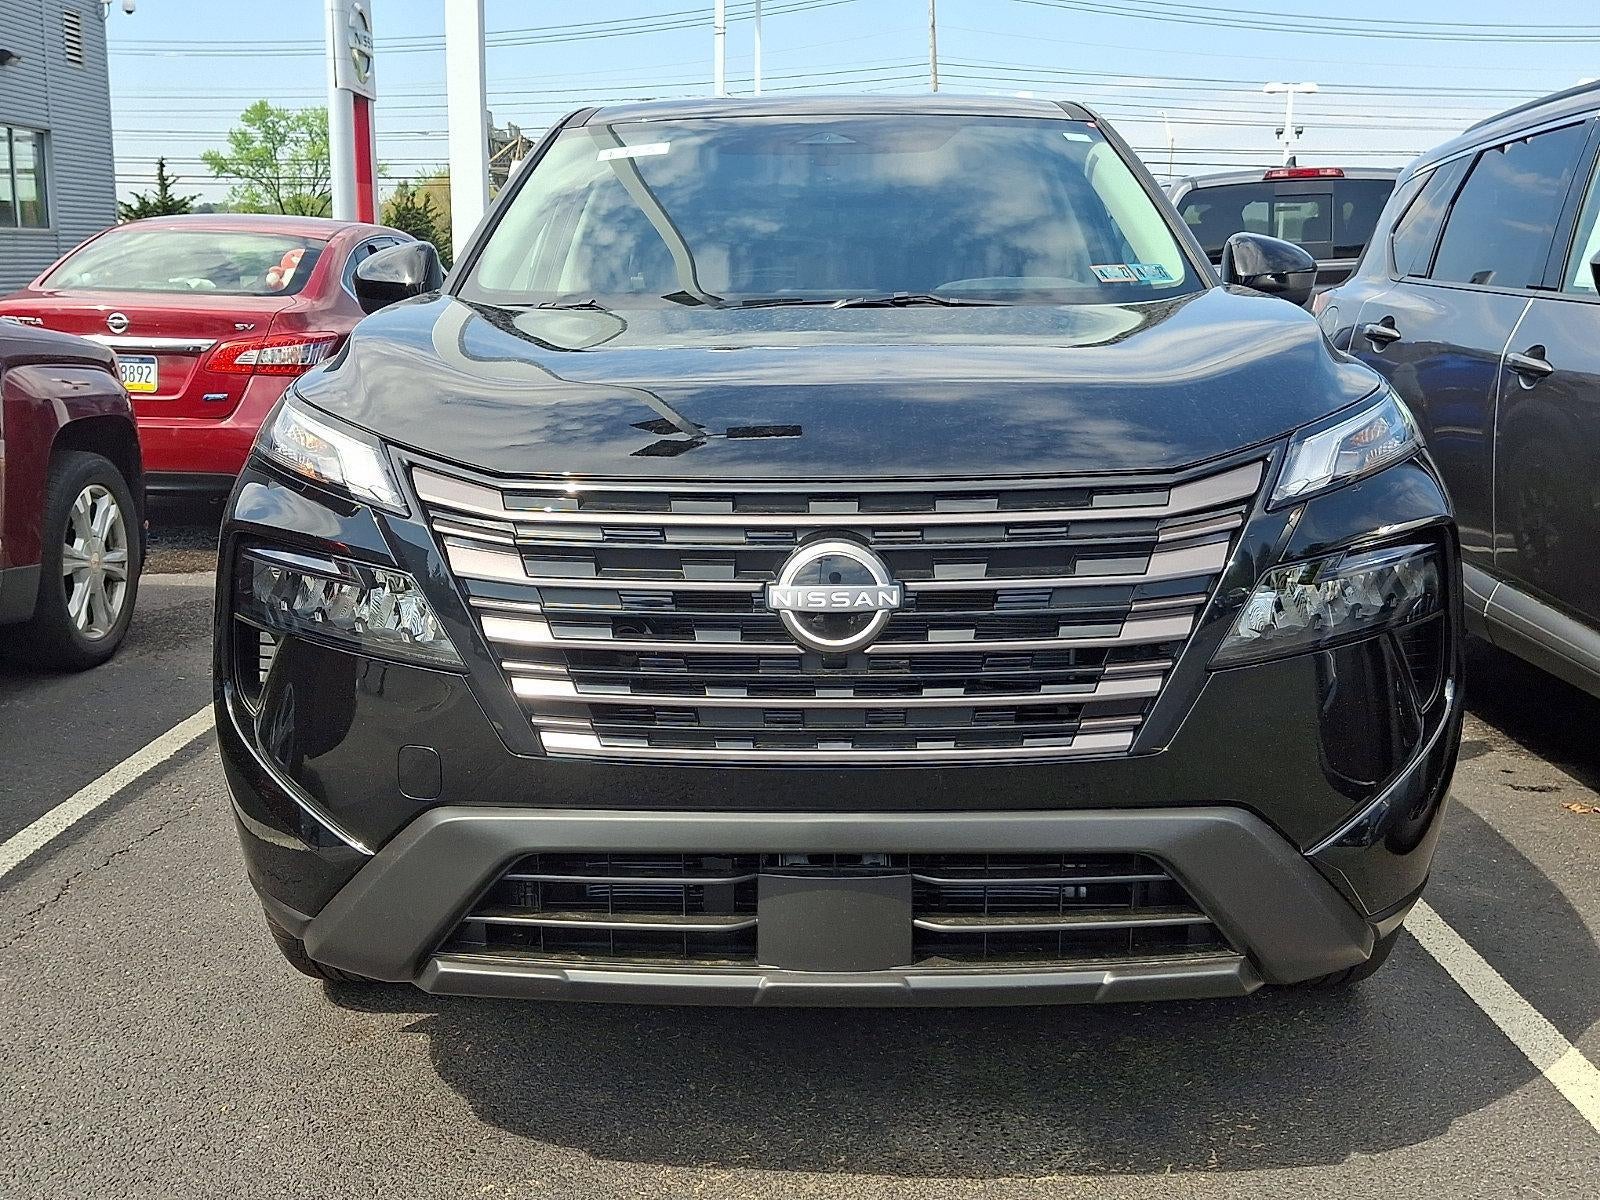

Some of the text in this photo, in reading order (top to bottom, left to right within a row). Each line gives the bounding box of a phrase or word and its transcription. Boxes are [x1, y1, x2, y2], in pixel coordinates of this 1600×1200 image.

[234, 323, 255, 331] SV
[120, 364, 152, 383] 8892
[771, 590, 898, 608] NISSAN
